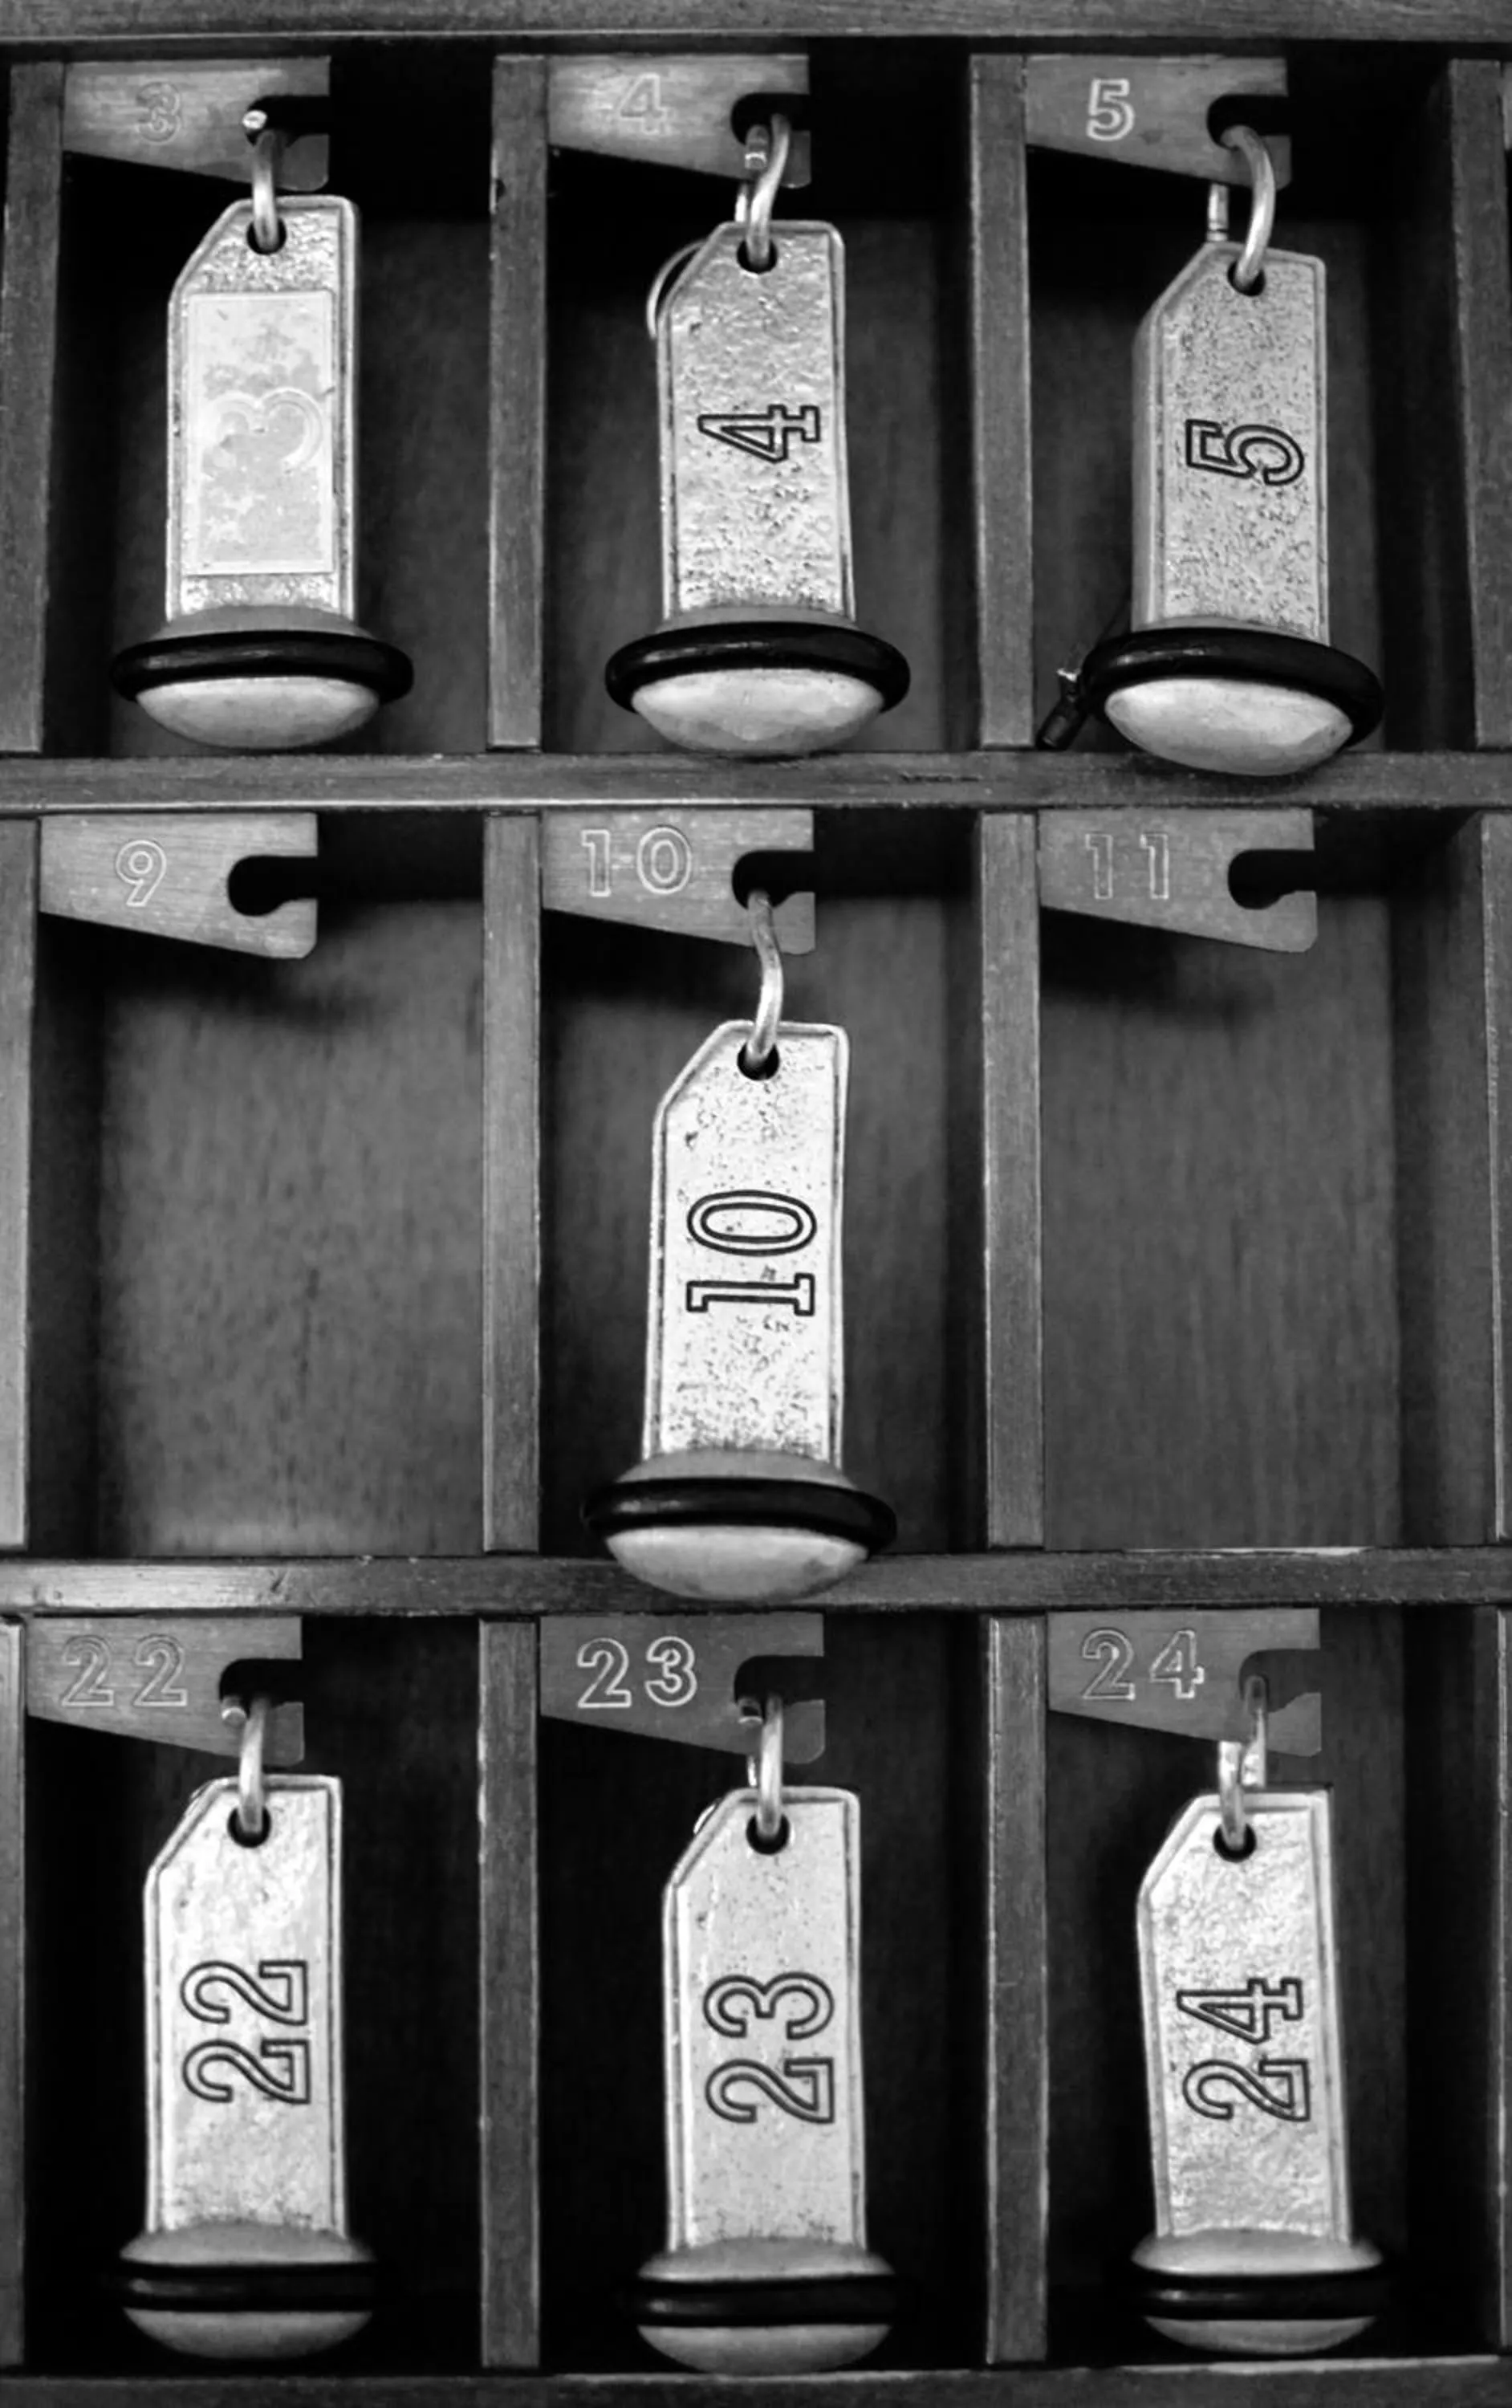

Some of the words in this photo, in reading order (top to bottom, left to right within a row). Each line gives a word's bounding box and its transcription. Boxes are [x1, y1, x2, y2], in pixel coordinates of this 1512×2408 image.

[617, 72, 668, 135] 4
[1086, 78, 1134, 141] 5
[697, 404, 820, 463] 4
[1185, 419, 1305, 486] 5
[116, 839, 167, 906] 9
[581, 824, 693, 897] 10
[1085, 832, 1169, 900] 11
[686, 1190, 817, 1317] 10
[60, 1633, 189, 1707] 22
[576, 1637, 698, 1708] 23
[1081, 1629, 1205, 1701] 24
[180, 1959, 311, 2105] 22
[703, 1971, 835, 2125] 23
[1176, 1977, 1310, 2122] 24
